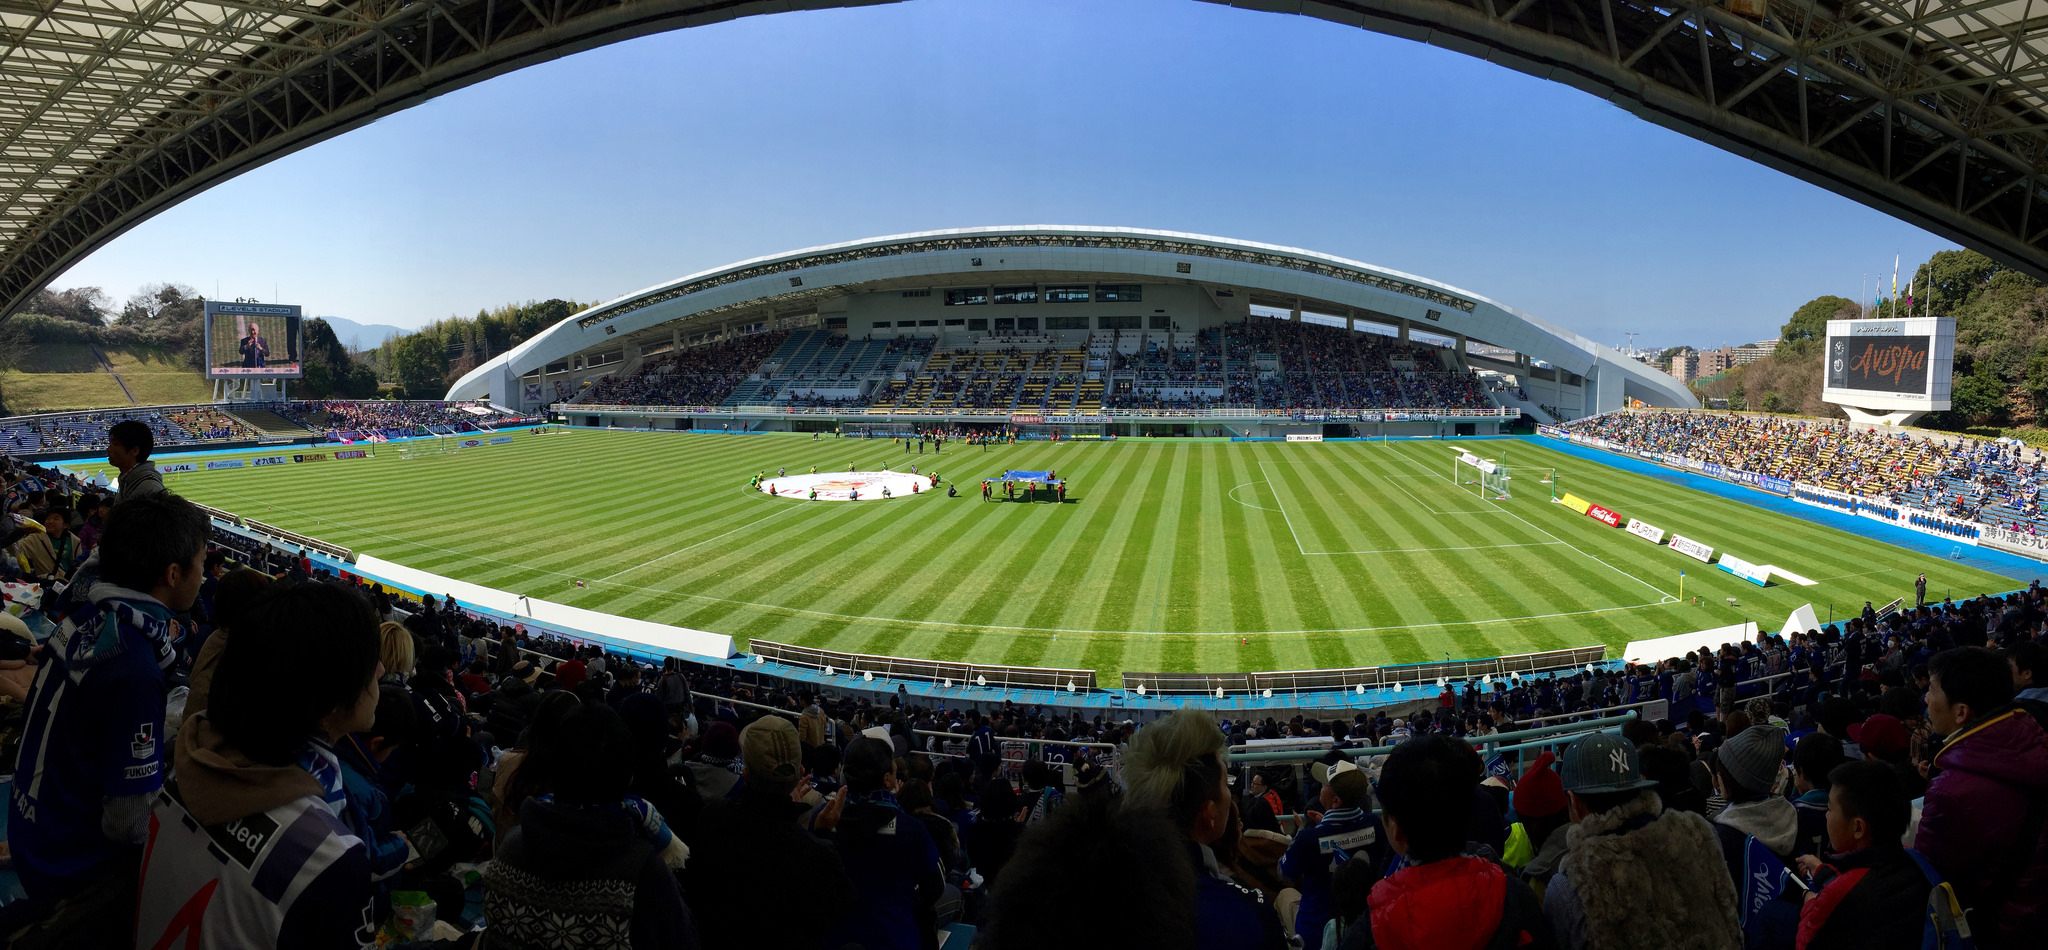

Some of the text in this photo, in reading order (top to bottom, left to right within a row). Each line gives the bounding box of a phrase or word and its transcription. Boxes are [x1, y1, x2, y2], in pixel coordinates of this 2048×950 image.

[1850, 343, 1926, 386] Avispa
[1861, 499, 1898, 522] PRINCE
[1909, 512, 1977, 540] KANAMORI
[1609, 747, 1630, 774] NY
